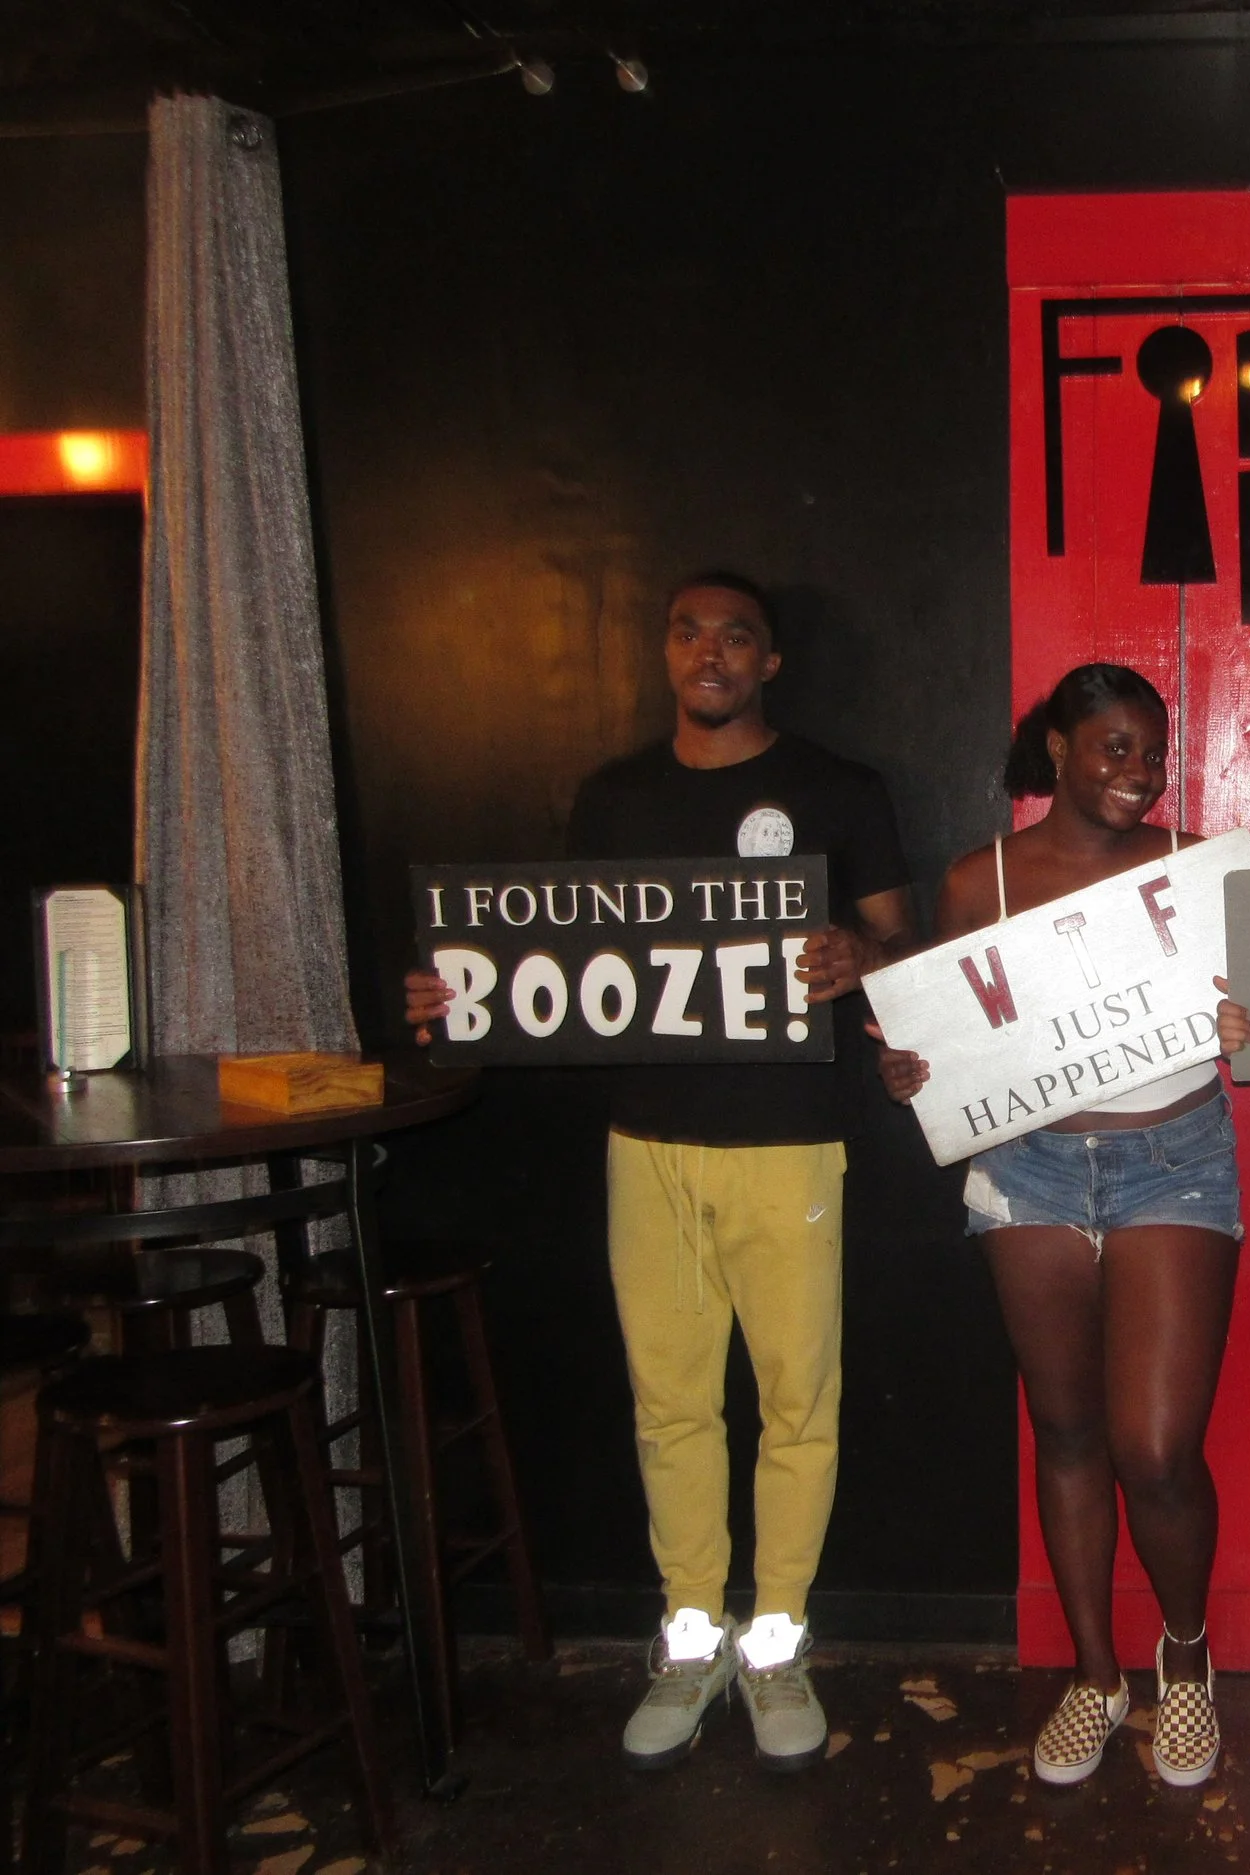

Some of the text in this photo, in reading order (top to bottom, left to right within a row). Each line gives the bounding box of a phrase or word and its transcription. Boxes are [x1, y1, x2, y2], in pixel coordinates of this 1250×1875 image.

[427, 880, 808, 927] I FOUND THE
[433, 937, 809, 1042] BOOZE!
[1049, 980, 1153, 1051] JUST
[961, 1011, 1218, 1138] HAPPENED
